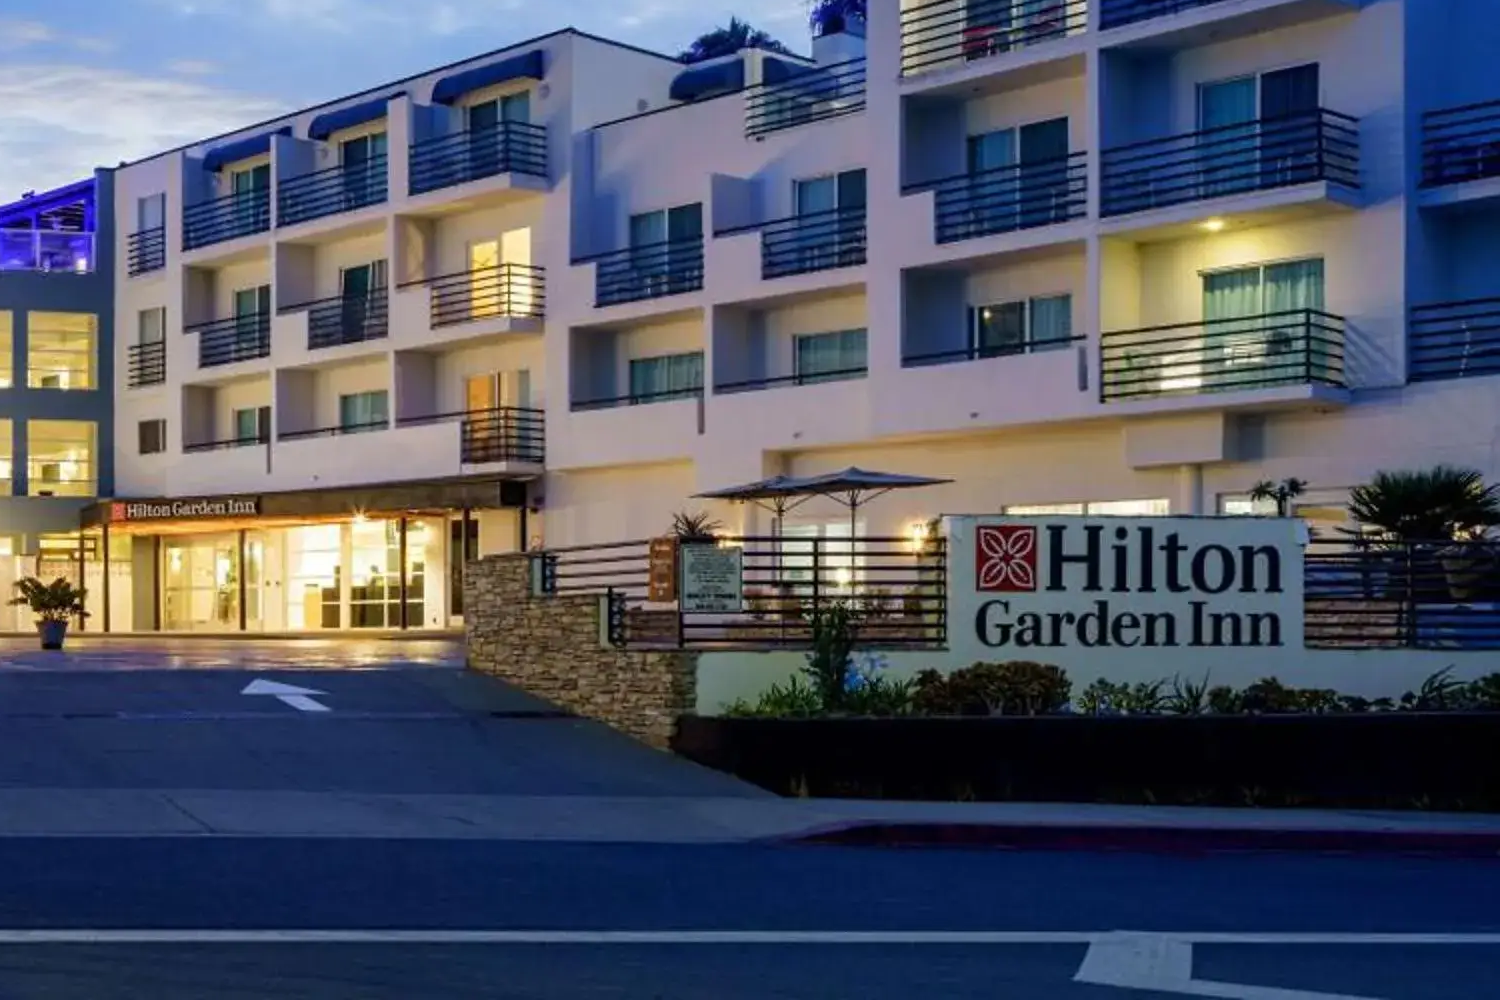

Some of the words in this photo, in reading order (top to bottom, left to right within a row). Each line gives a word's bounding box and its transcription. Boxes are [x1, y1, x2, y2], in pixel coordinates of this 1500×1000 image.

[126, 502, 171, 518] Hilton
[172, 501, 226, 516] Garden
[227, 499, 256, 514] Inn
[1045, 524, 1284, 595] Hilton
[974, 599, 1180, 648] Garden
[1187, 601, 1285, 648] Inn
